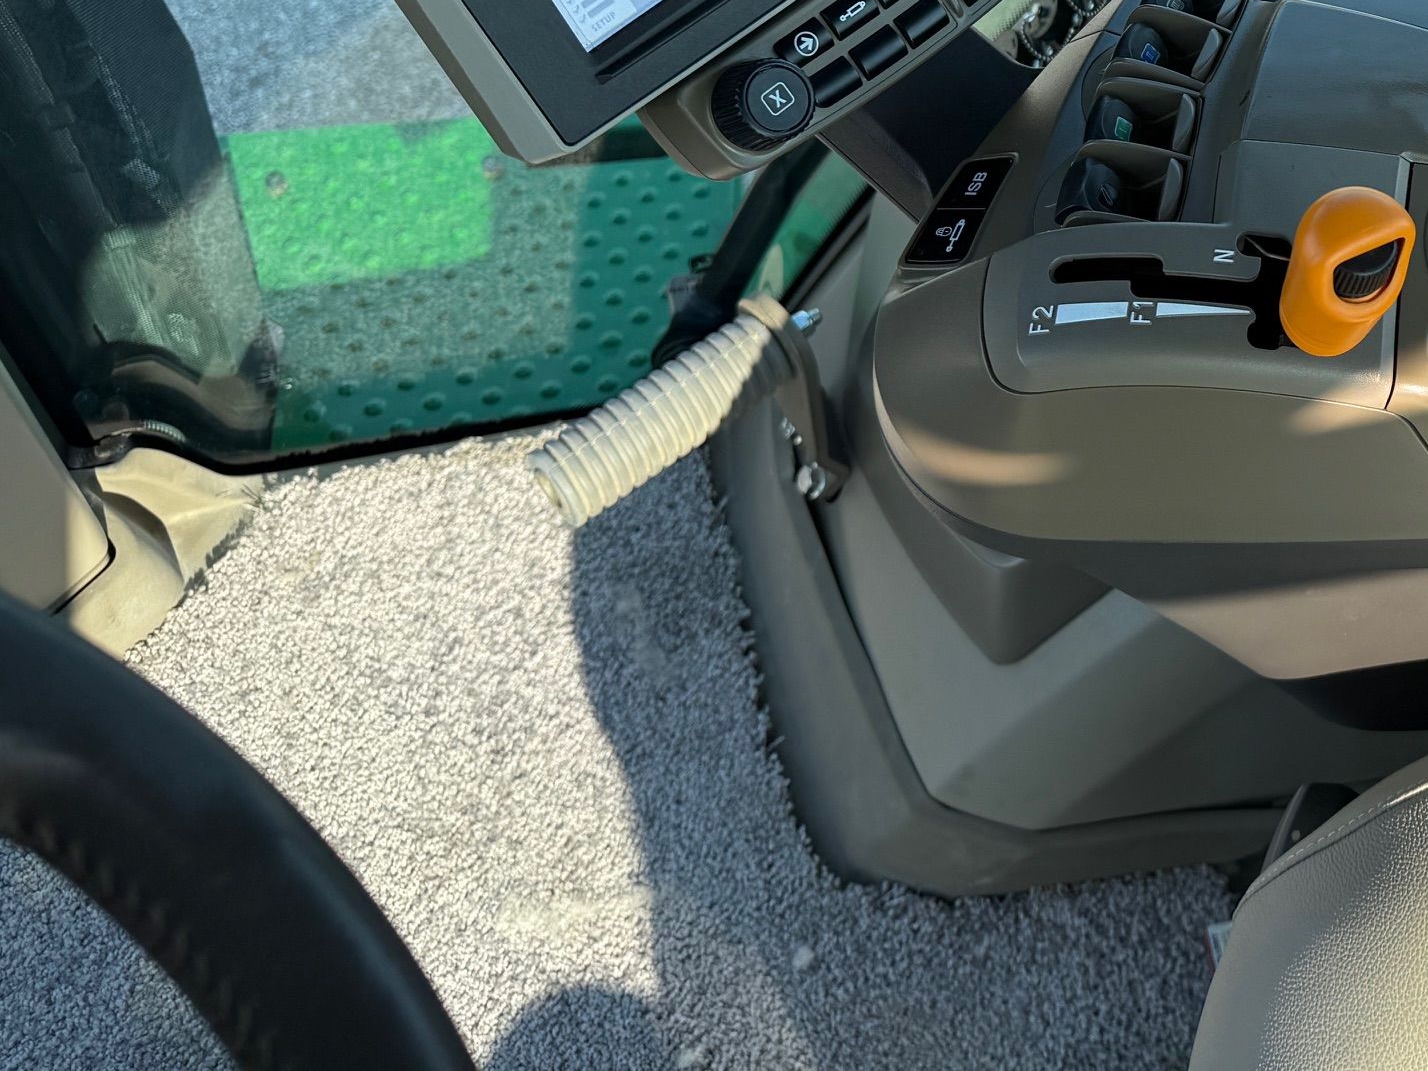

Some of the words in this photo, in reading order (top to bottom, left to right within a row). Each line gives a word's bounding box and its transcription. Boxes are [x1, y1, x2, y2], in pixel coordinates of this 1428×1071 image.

[591, 11, 615, 32] SETUP
[964, 172, 988, 196] ISB
[1213, 248, 1235, 263] N
[1028, 305, 1054, 336] F2
[1129, 301, 1154, 326] F1
